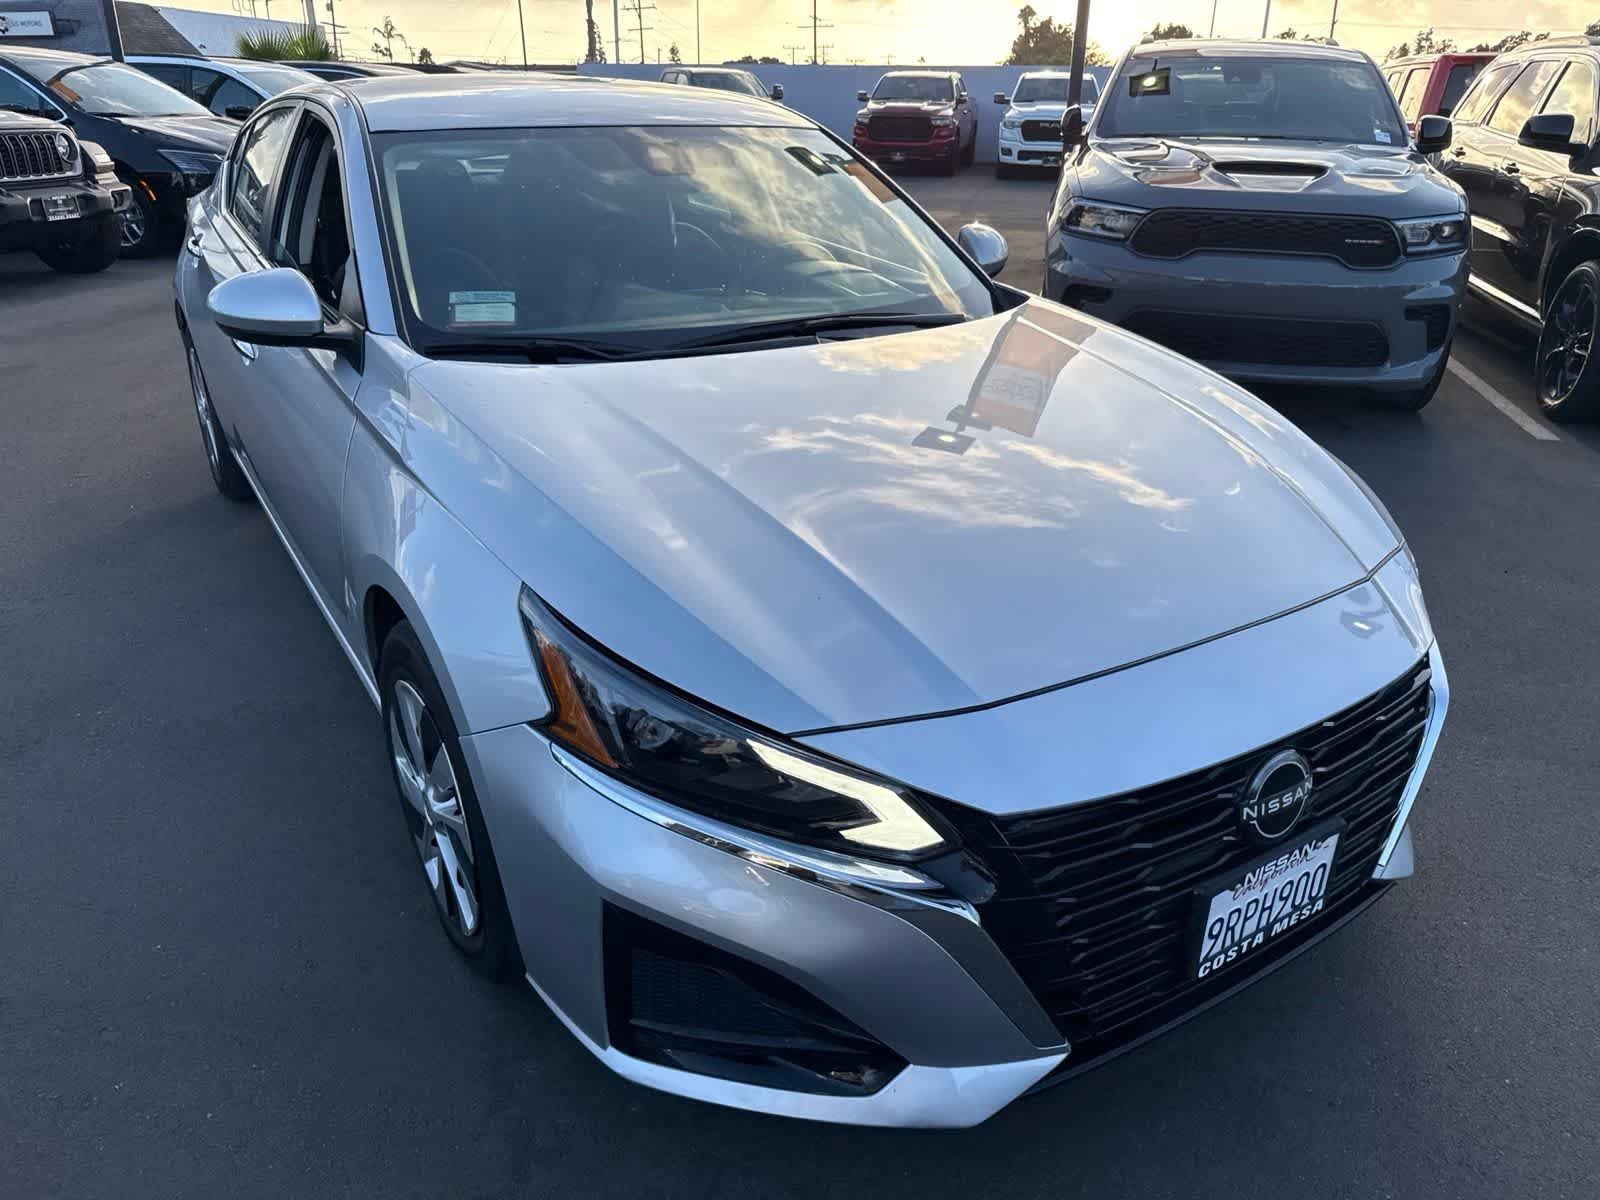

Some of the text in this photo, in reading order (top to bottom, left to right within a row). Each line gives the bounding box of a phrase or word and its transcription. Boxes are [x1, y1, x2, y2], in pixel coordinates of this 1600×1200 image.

[1243, 777, 1312, 820] NISSAN
[1243, 839, 1316, 886] NISSAN
[1198, 899, 1324, 978] COSTA MESA
[1202, 862, 1327, 961] 9RPH900
